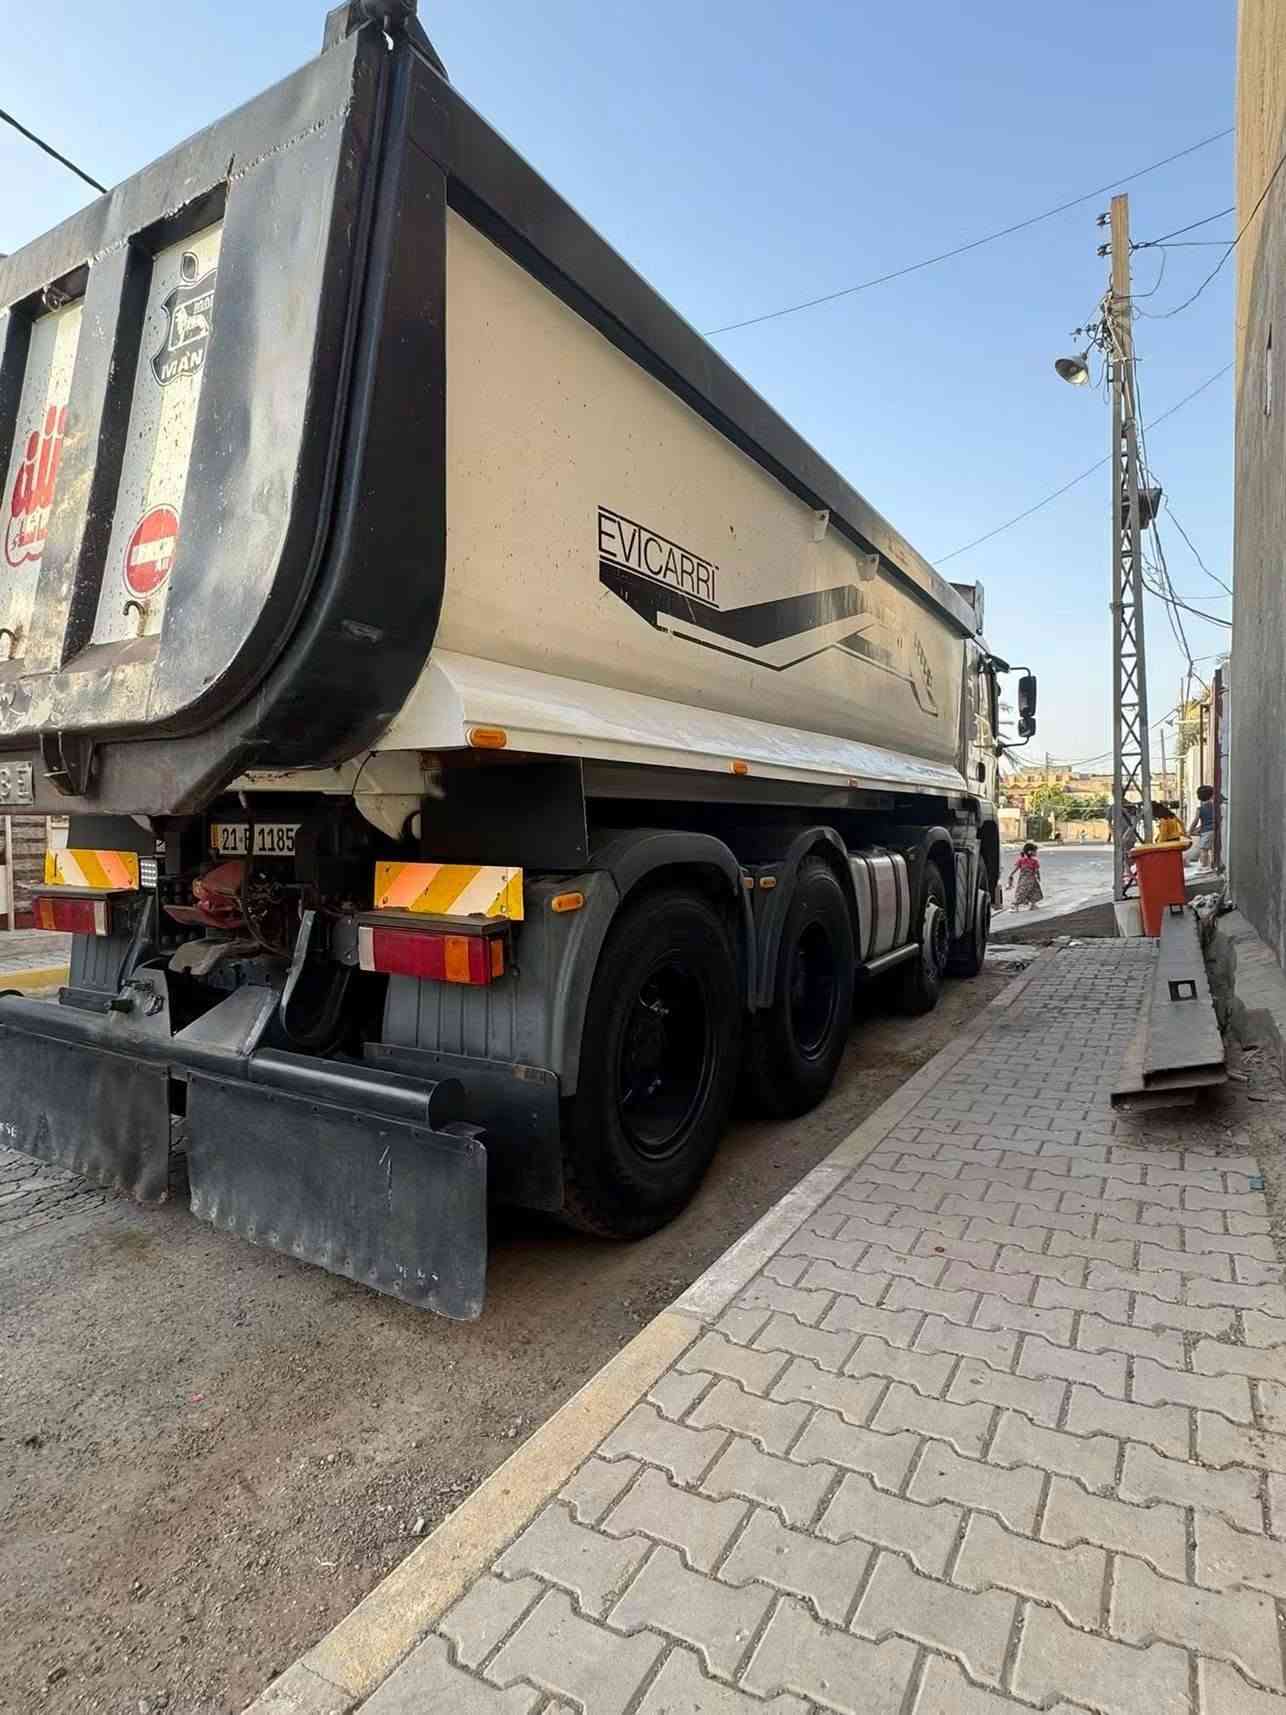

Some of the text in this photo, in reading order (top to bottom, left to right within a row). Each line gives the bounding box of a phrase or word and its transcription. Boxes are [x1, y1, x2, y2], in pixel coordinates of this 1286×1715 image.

[161, 350, 203, 379] MAN
[598, 511, 716, 601] EVICARRI
[222, 827, 237, 851] 21
[258, 827, 295, 852] 1185
